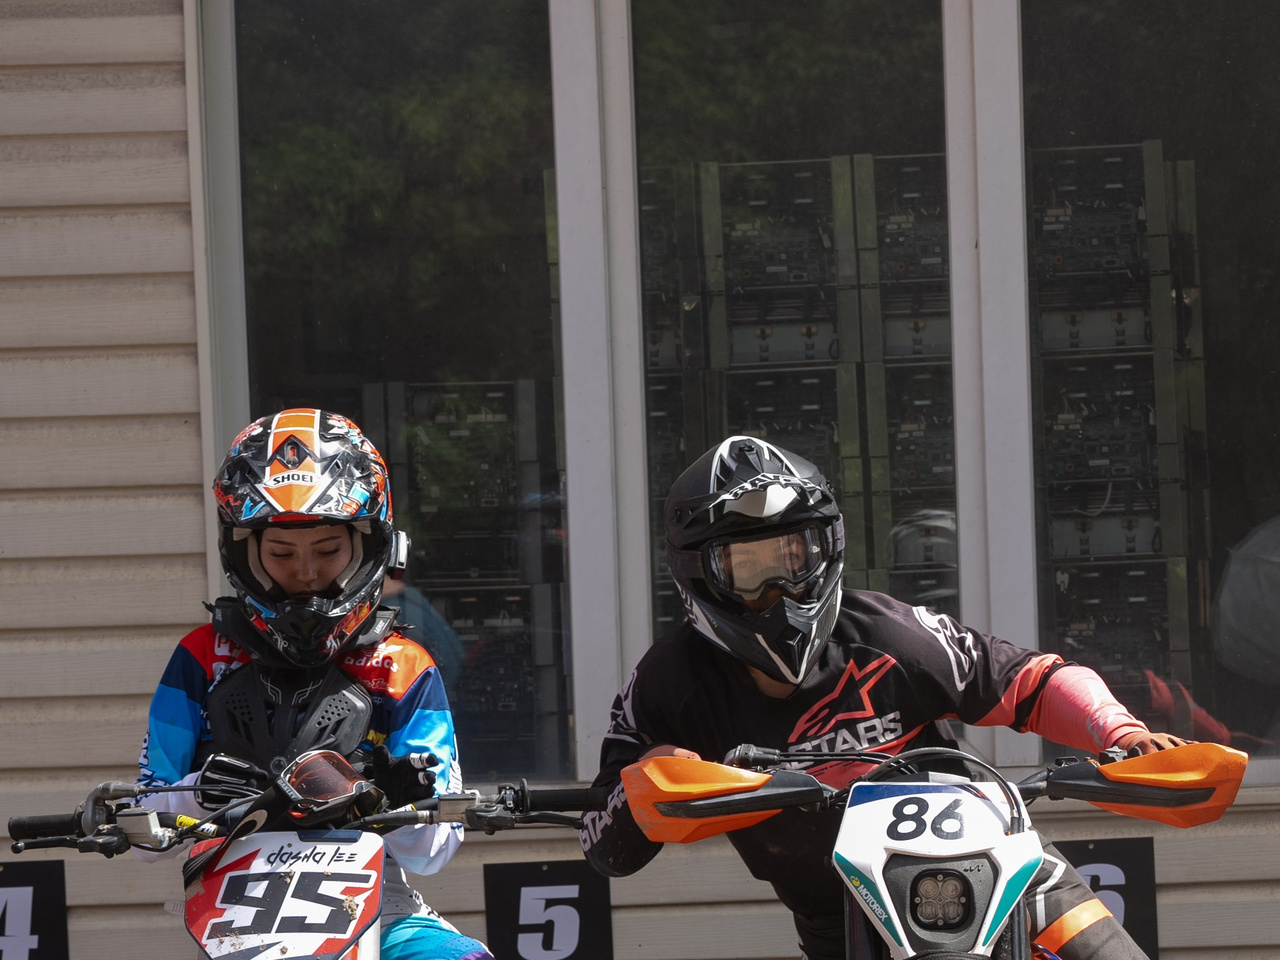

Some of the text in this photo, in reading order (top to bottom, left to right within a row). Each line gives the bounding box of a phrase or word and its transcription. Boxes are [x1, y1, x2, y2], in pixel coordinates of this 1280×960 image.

[272, 473, 314, 486] SHOEI
[344, 654, 399, 673] adidas
[277, 779, 298, 800] OAKLEY
[886, 796, 966, 841] 86
[206, 871, 373, 940] 95
[857, 884, 888, 923] MOTOREX
